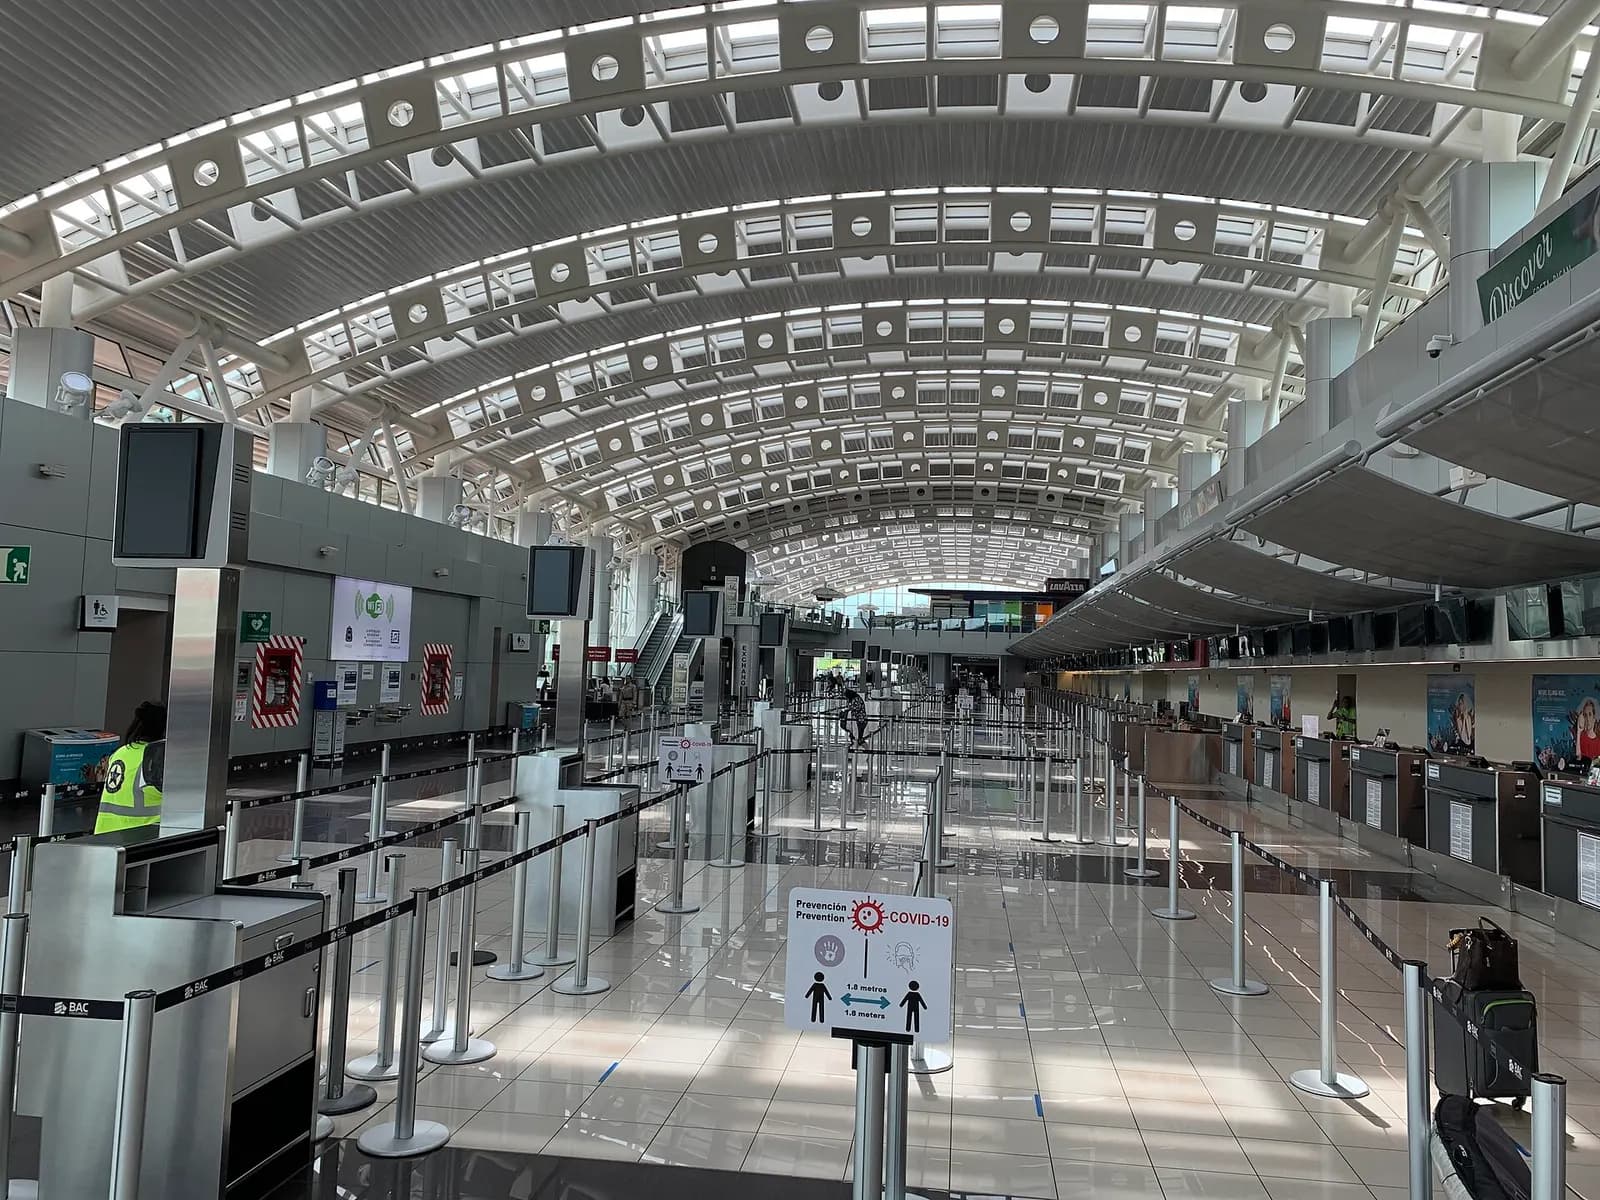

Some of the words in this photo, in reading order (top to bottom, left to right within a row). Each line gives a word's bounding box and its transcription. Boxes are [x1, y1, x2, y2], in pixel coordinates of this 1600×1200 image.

[1050, 581, 1085, 591] LAVAZZA
[796, 899, 847, 912] Prevención
[796, 911, 845, 923] Prevention
[889, 911, 949, 927] COVID-19
[273, 950, 284, 962] BAC
[194, 979, 208, 993] BAC
[860, 984, 887, 993] metros
[69, 1002, 89, 1013] BAC
